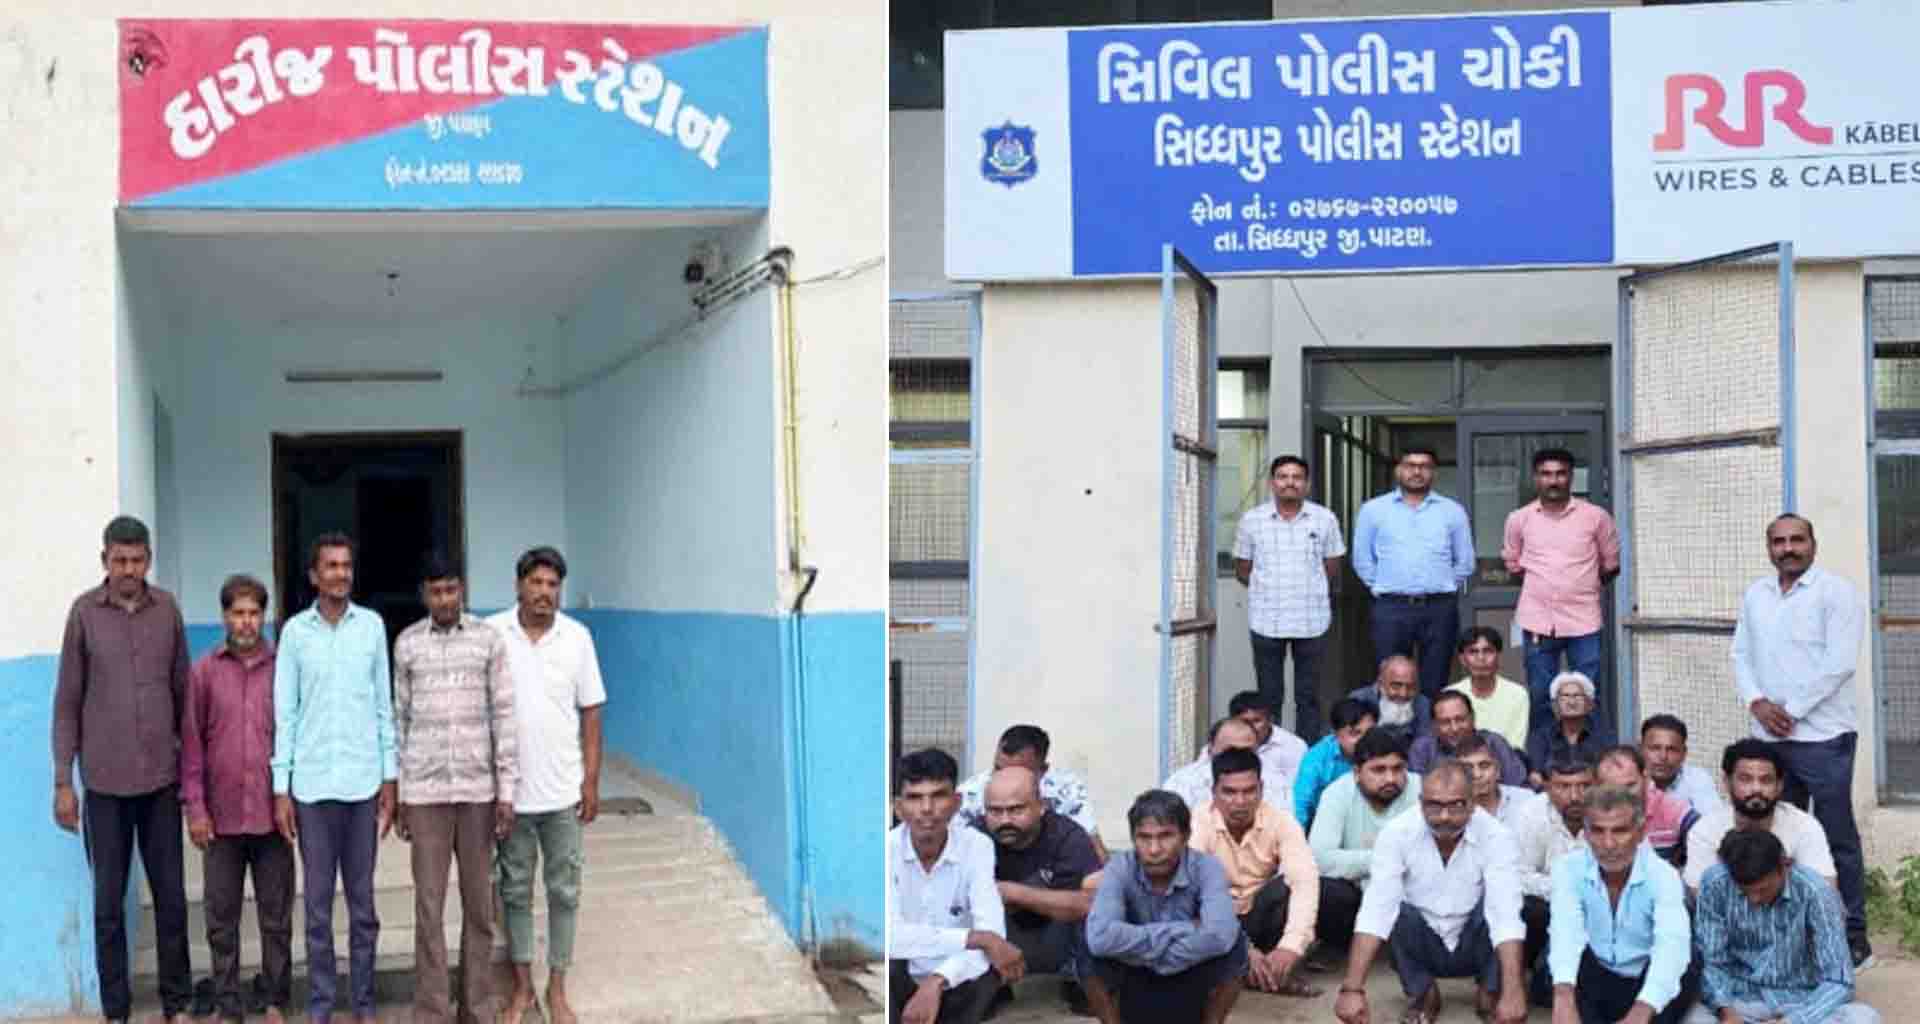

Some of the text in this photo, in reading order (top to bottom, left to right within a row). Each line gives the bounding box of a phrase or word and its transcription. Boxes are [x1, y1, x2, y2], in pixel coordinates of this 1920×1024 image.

[164, 29, 731, 169] હારીજ પોલીસ સ્ટેશન
[1098, 24, 1582, 103] સિવિલ પોલીસ ચોકી
[1154, 103, 1522, 182] સિધ્ધપુર પોલીસ સ્ટેશન
[1652, 69, 1834, 151] RR
[1191, 194, 1233, 226] ફોન
[1654, 168, 1758, 192] WIRES
[1769, 167, 1789, 188] &
